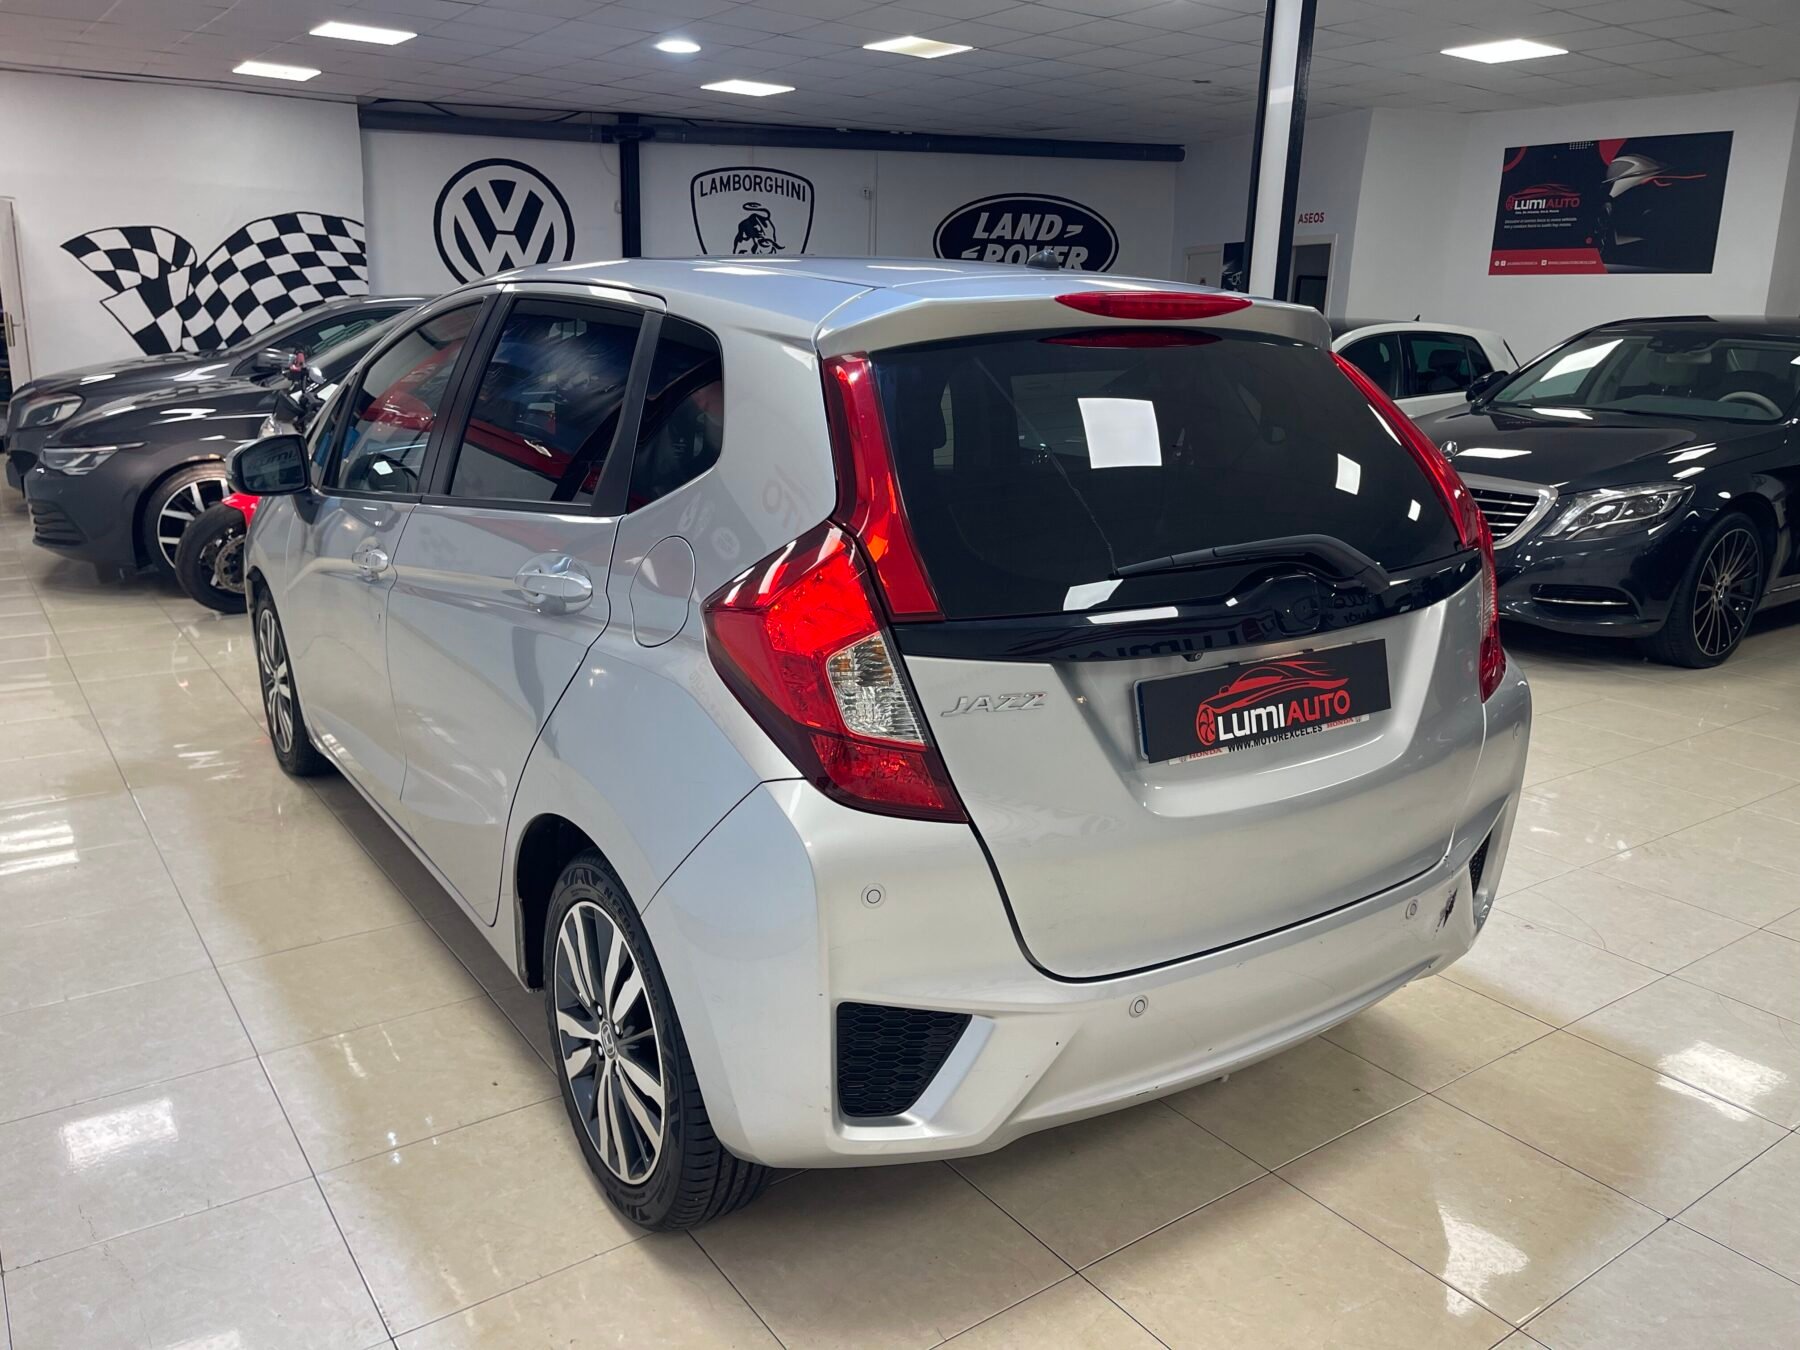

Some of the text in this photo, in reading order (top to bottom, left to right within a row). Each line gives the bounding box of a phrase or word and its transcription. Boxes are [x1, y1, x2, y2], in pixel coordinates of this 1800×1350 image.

[700, 174, 806, 202] LAMBORGHINI
[972, 212, 1063, 241] LAND
[1298, 212, 1325, 224] ASEOS
[983, 244, 1089, 271] ROER
[940, 691, 1047, 717] JAZZ
[1217, 690, 1351, 741] LUMIAUTO
